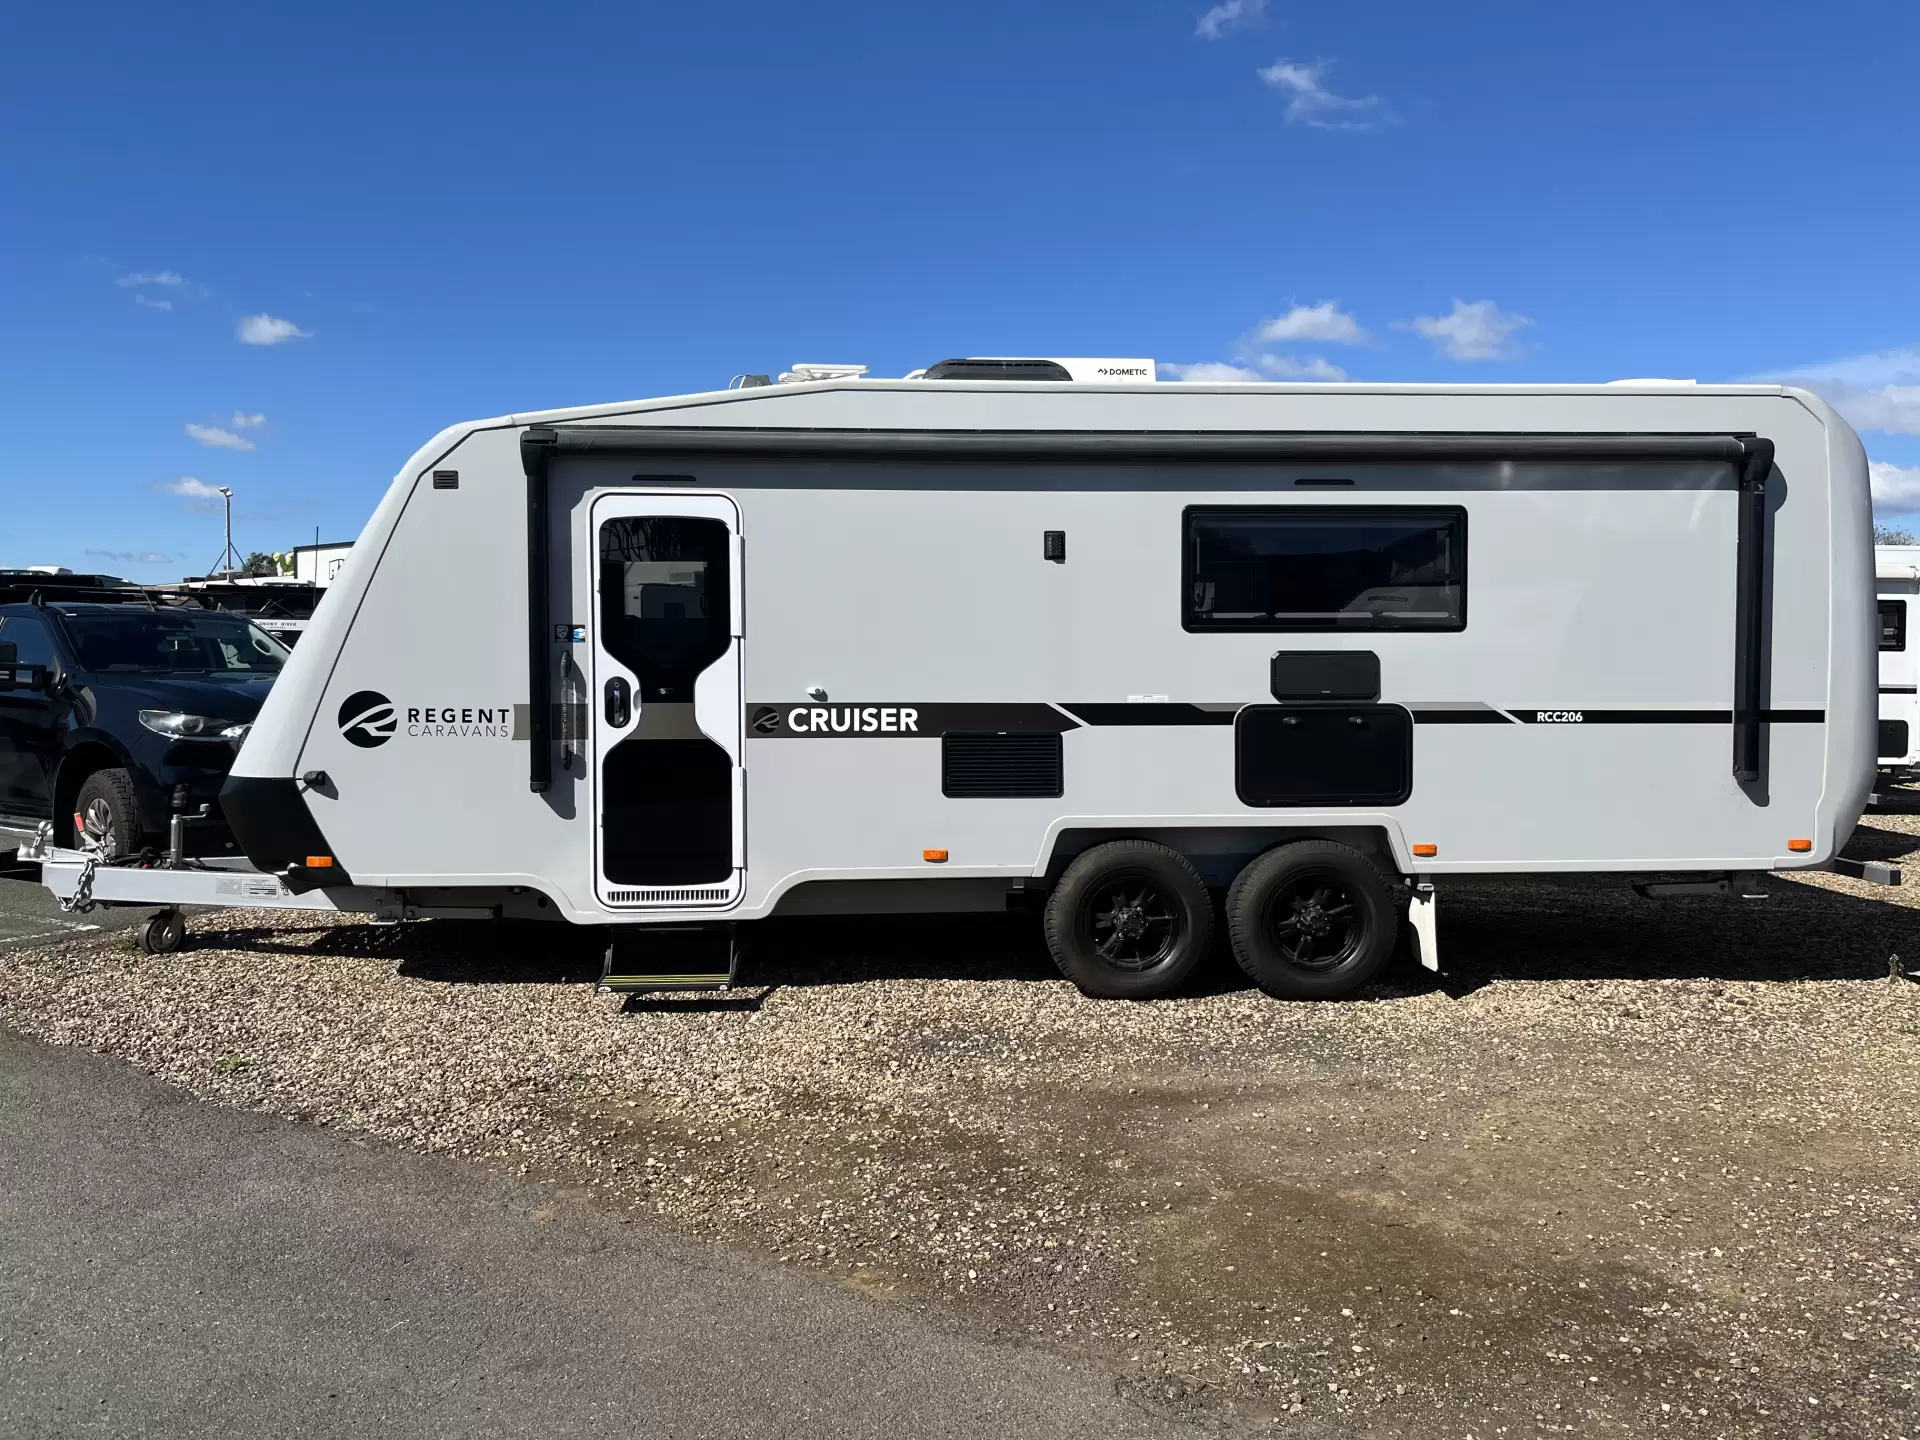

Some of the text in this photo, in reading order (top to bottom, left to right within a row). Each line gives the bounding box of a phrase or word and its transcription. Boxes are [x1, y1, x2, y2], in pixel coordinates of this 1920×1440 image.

[1109, 368, 1148, 376] DOMETIC
[407, 708, 510, 723] REGENT
[787, 707, 919, 733] CRUISER
[1536, 711, 1583, 722] RCC206
[408, 725, 509, 738] CARAVANS
